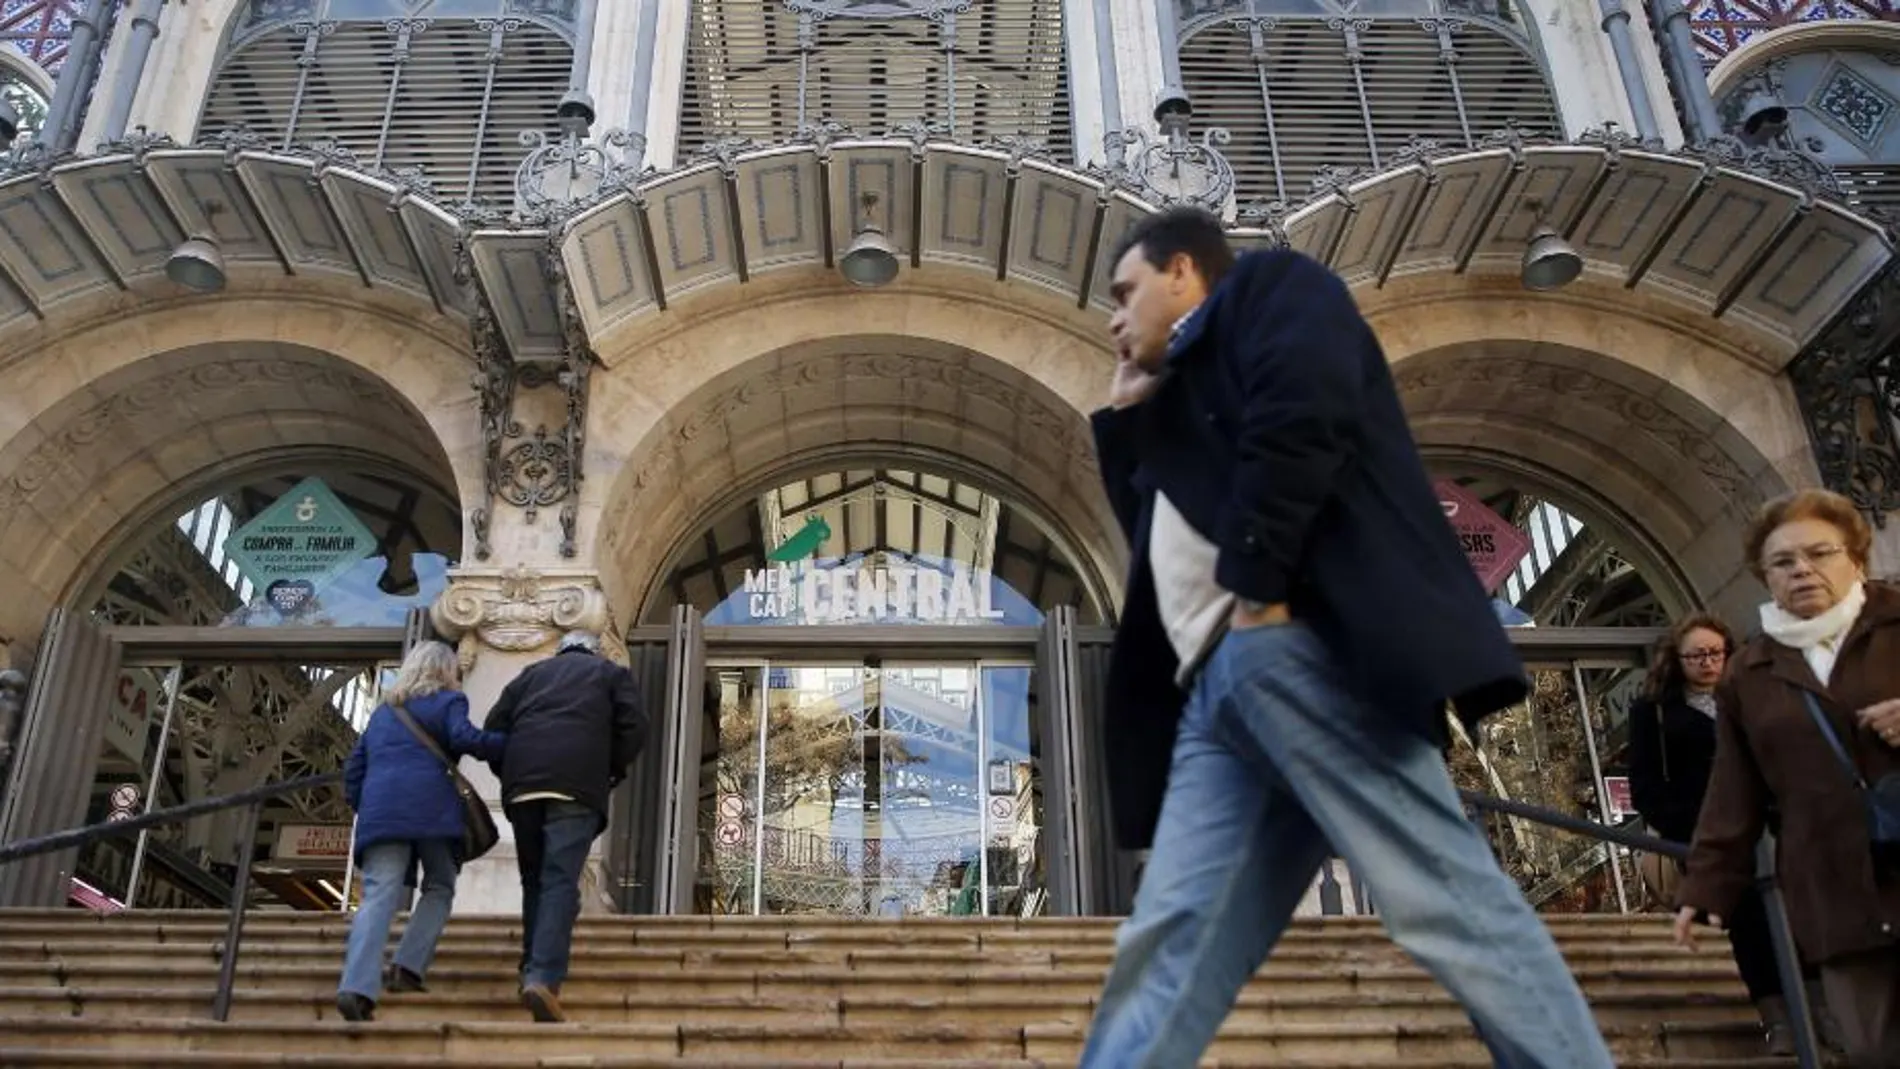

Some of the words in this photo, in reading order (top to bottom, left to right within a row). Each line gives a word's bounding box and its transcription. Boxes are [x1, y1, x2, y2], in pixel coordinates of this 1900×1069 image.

[243, 535, 294, 551] COMPRA
[306, 535, 355, 551] FAMILIA
[804, 568, 1004, 618] CENTRAL
[116, 674, 147, 722] CA
